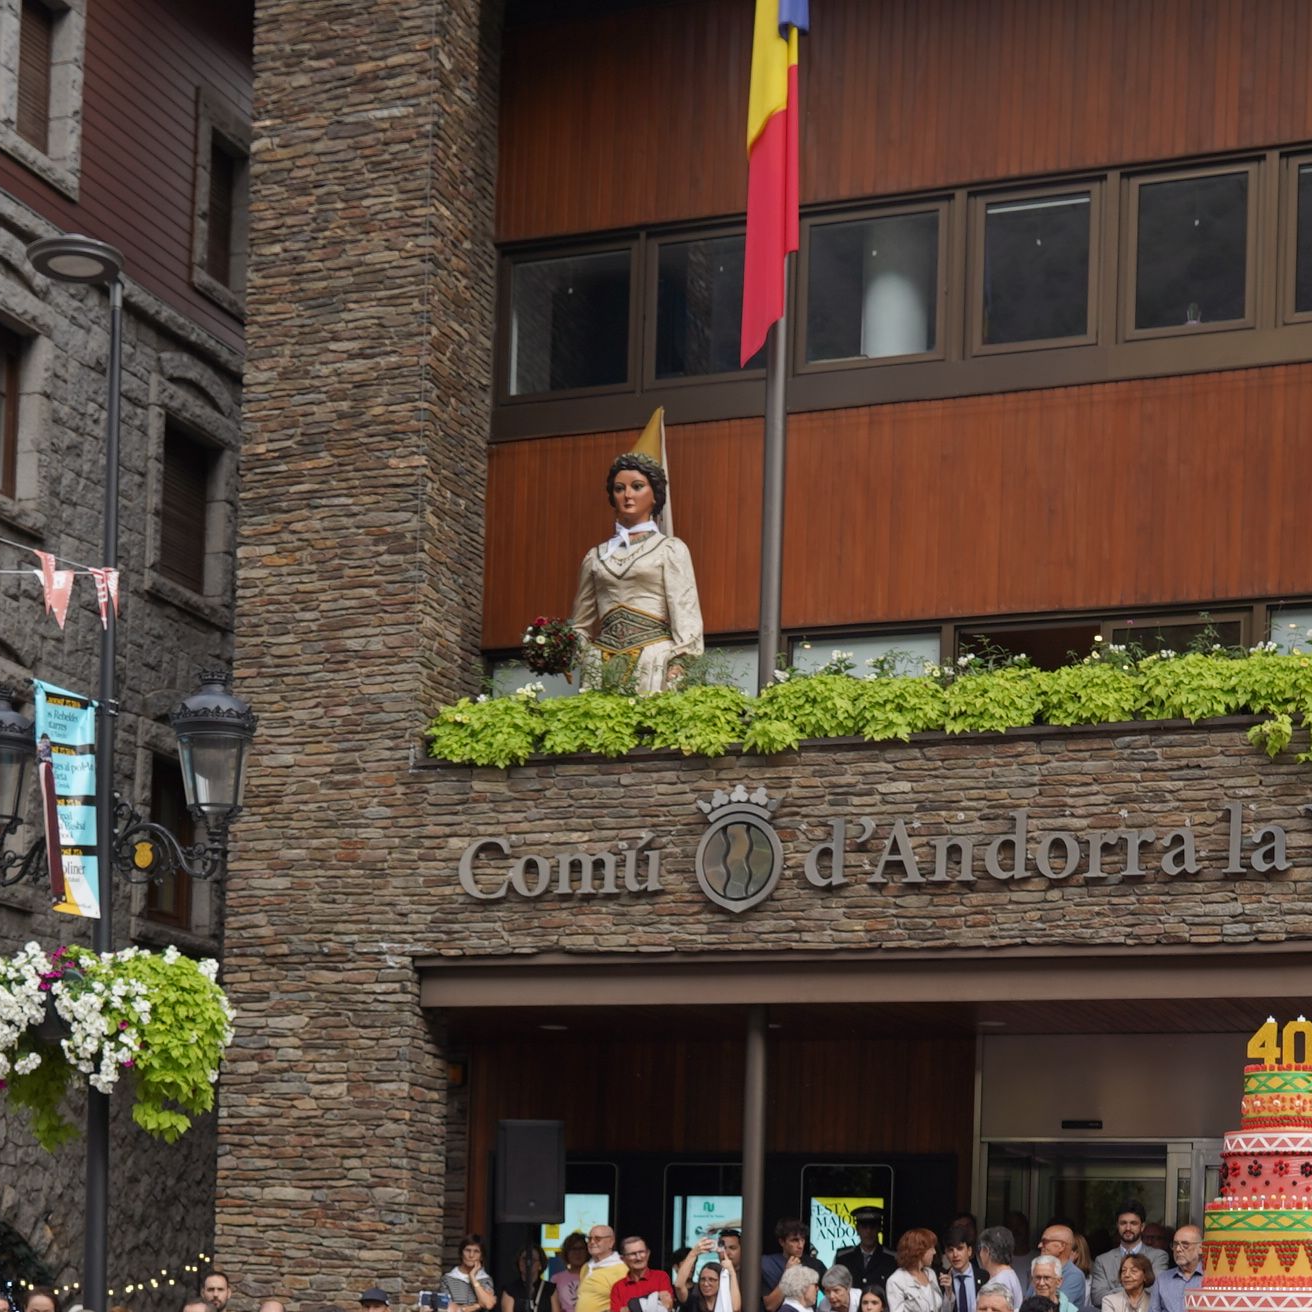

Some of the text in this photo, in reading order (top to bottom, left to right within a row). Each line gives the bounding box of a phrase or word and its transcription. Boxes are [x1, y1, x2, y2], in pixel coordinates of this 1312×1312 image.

[458, 831, 664, 900] Comú
[803, 808, 1202, 889] d'Andorra
[1223, 800, 1290, 874] la
[816, 1215, 857, 1228] MAJO
